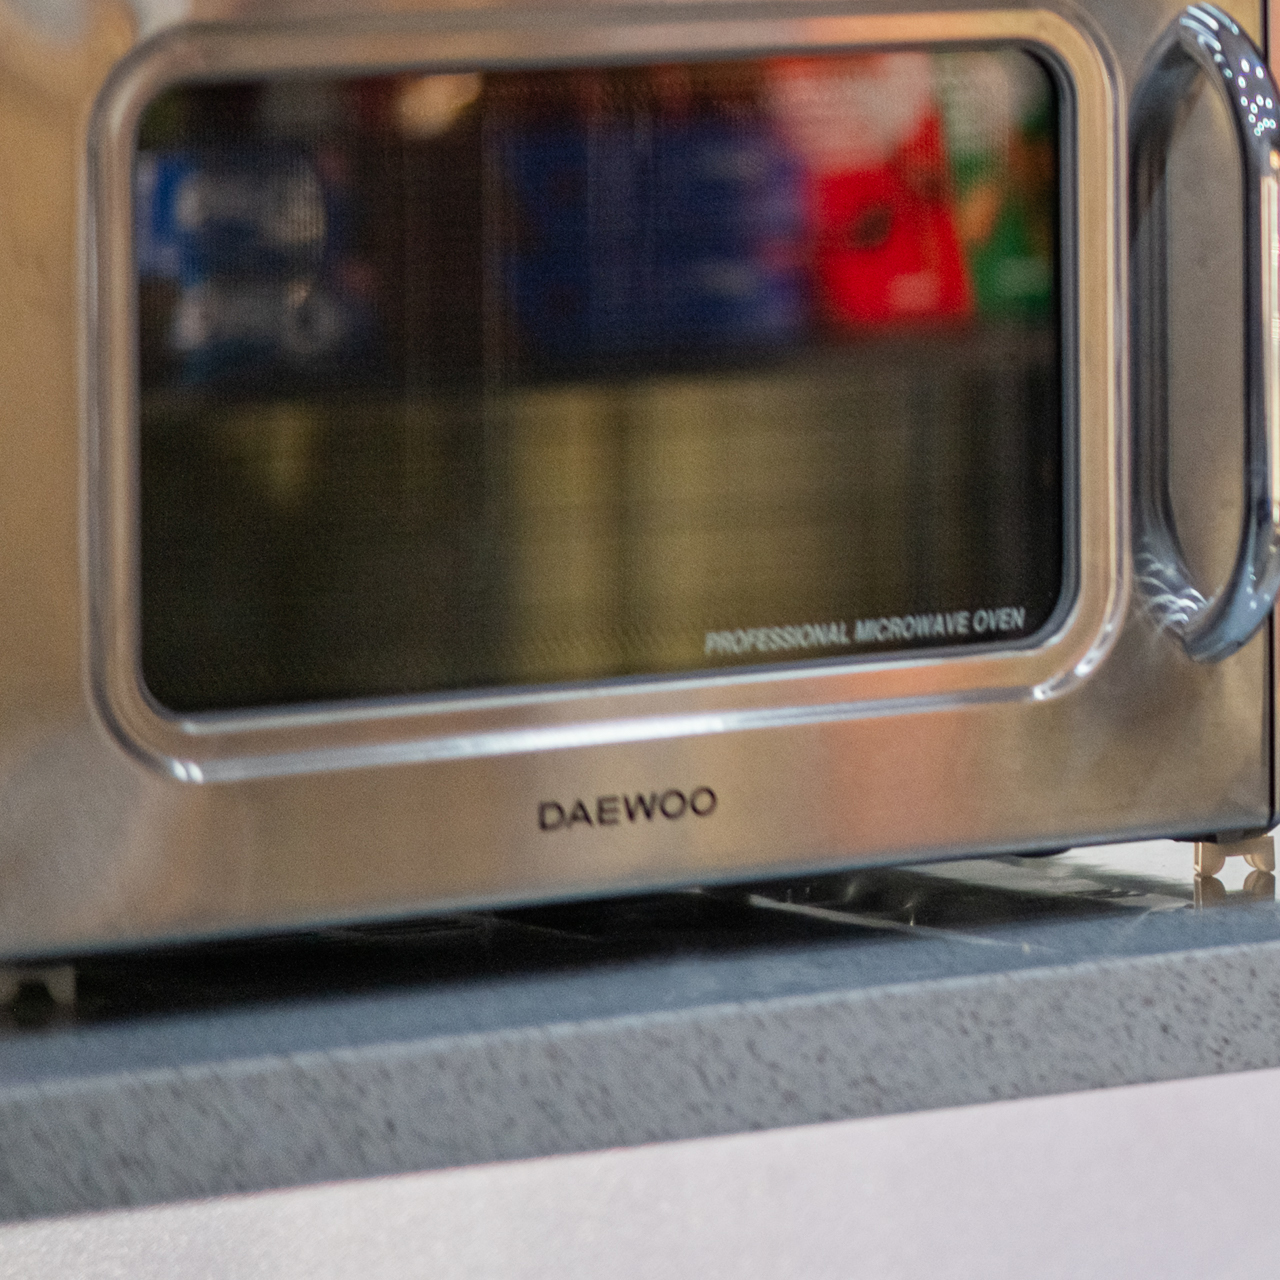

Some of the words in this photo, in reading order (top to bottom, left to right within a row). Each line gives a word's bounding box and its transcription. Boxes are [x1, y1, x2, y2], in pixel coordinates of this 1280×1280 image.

[704, 621, 850, 656] PROFESSIONAL
[854, 609, 971, 643] MICROWAVE
[973, 606, 1026, 633] OVEN
[538, 786, 719, 832] DAEWOO
